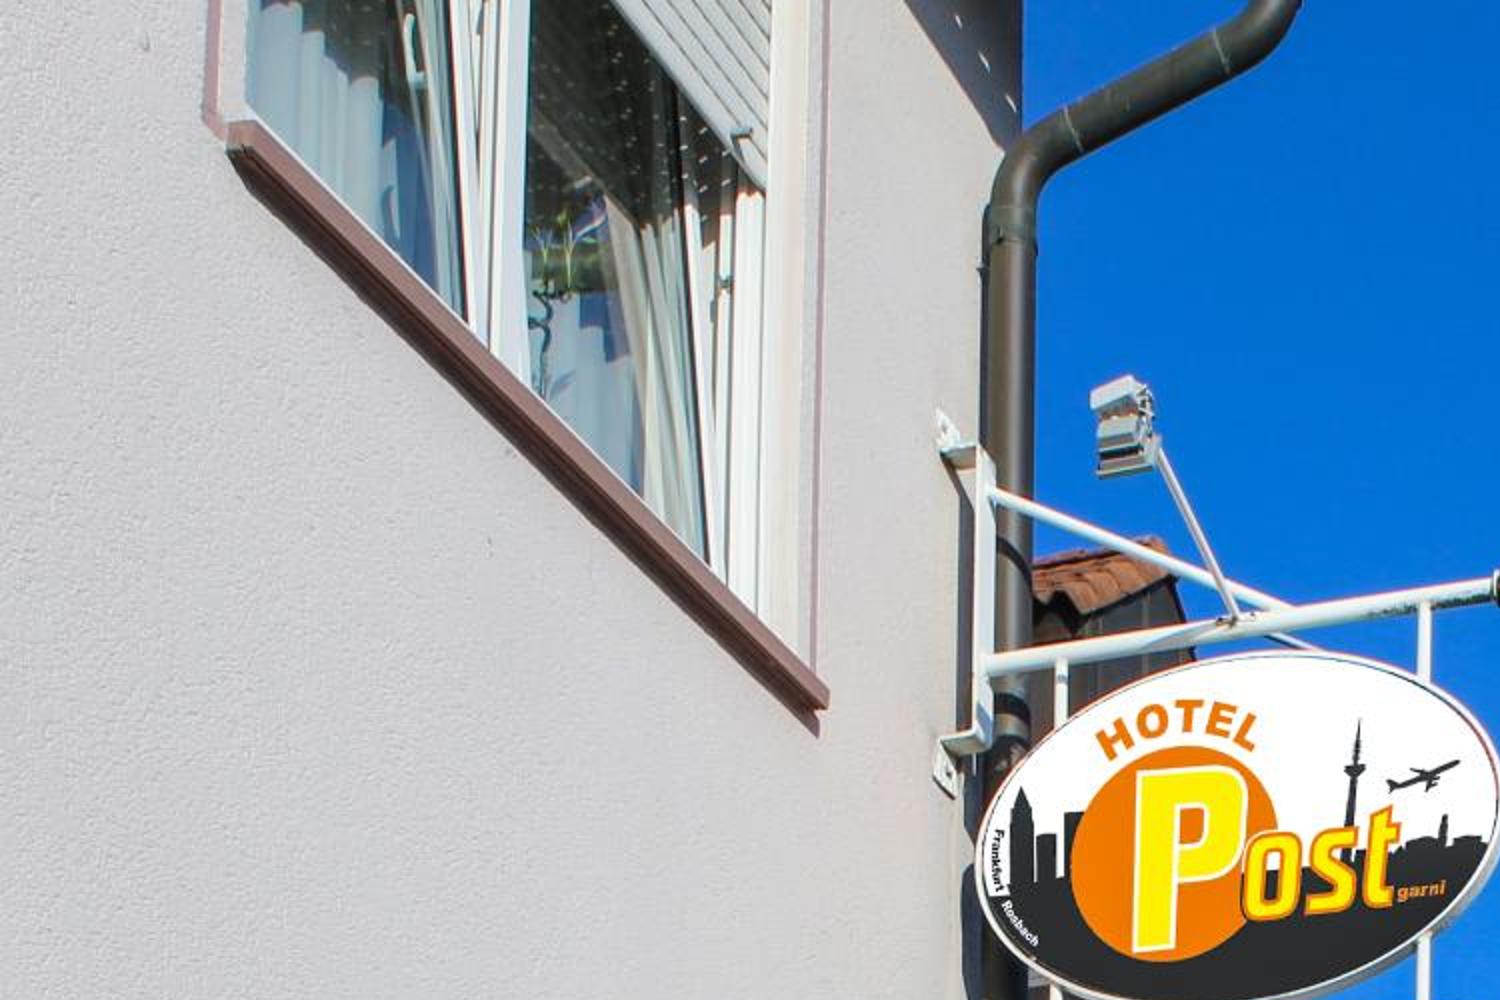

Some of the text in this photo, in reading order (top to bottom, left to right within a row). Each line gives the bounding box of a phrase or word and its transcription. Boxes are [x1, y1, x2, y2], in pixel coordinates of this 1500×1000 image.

[1095, 699, 1257, 762] HOTEL
[991, 829, 1039, 947] Frankfurt Rosbach
[1132, 764, 1402, 953] Post
[1397, 879, 1447, 903] garni
